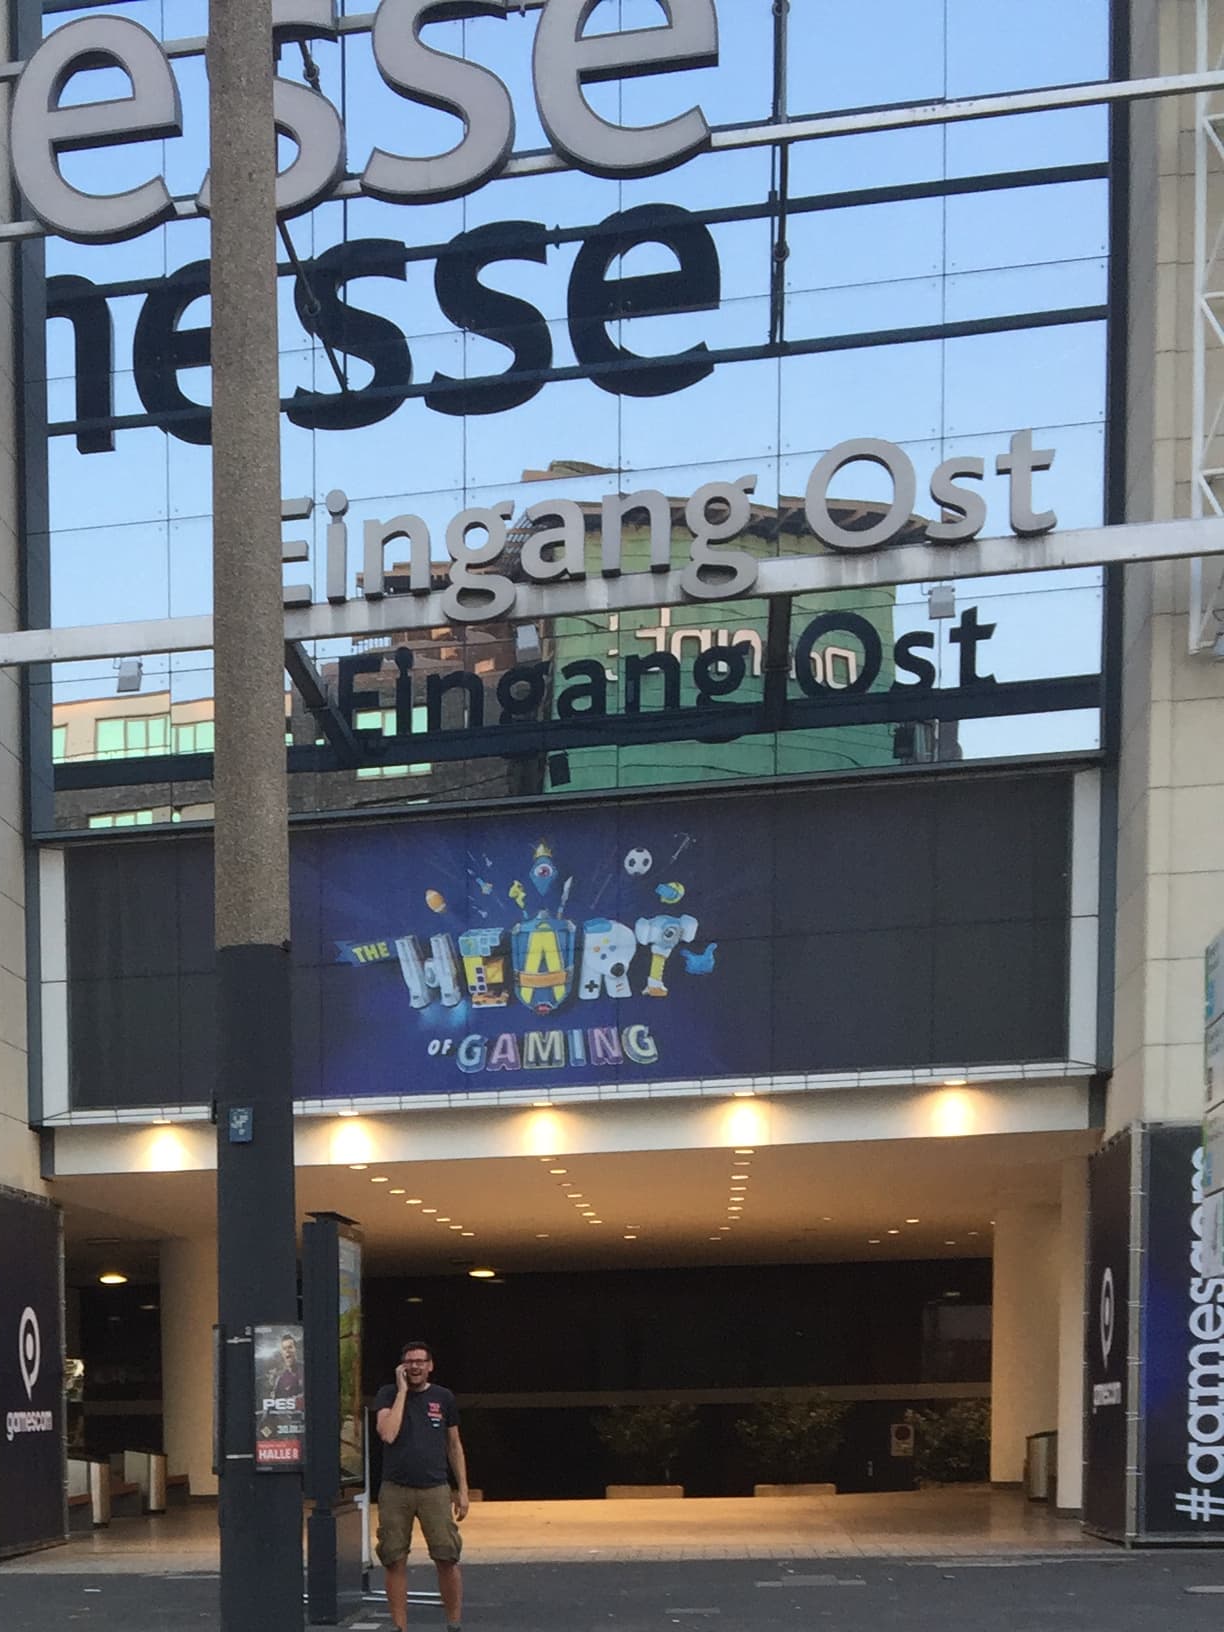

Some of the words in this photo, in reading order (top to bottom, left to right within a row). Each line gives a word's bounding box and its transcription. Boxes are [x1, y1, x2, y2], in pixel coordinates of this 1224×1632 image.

[807, 429, 1058, 553] Ost
[794, 606, 997, 700] Ost
[353, 941, 390, 964] THE
[393, 912, 699, 1015] HEART
[427, 1039, 452, 1056] OF
[455, 1023, 659, 1074] GAMING
[1175, 1146, 1224, 1522] #games
[6, 1410, 53, 1441] gamescom
[262, 1398, 296, 1411] PES
[258, 1449, 290, 1460] HALLE
